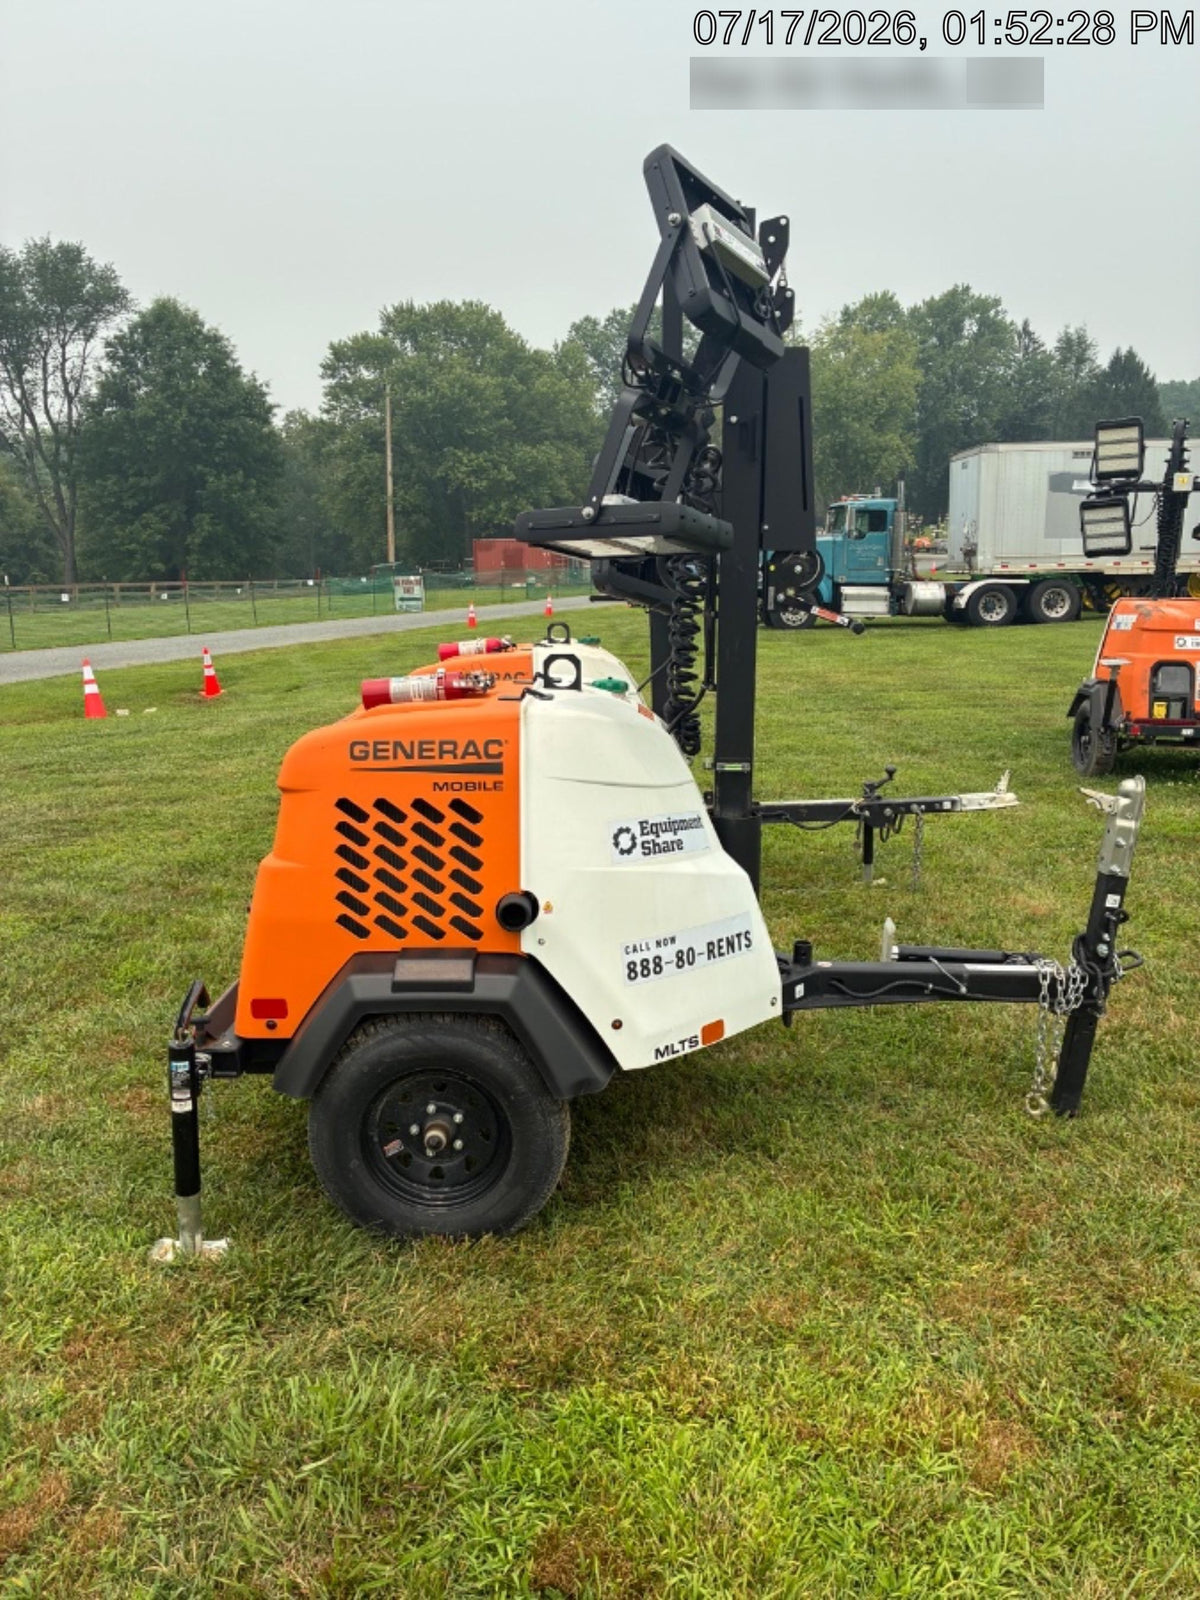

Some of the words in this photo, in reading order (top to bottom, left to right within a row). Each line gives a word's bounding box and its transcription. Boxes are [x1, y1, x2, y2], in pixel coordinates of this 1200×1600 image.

[349, 739, 504, 761] GENERAC
[433, 781, 504, 792] MOBILE
[638, 814, 704, 838] Equipment
[641, 838, 684, 856] Share
[624, 942, 651, 955] CALL
[655, 935, 677, 949] NOW
[626, 930, 753, 981] 888-80-RENTS
[654, 1034, 700, 1060] MLTS
